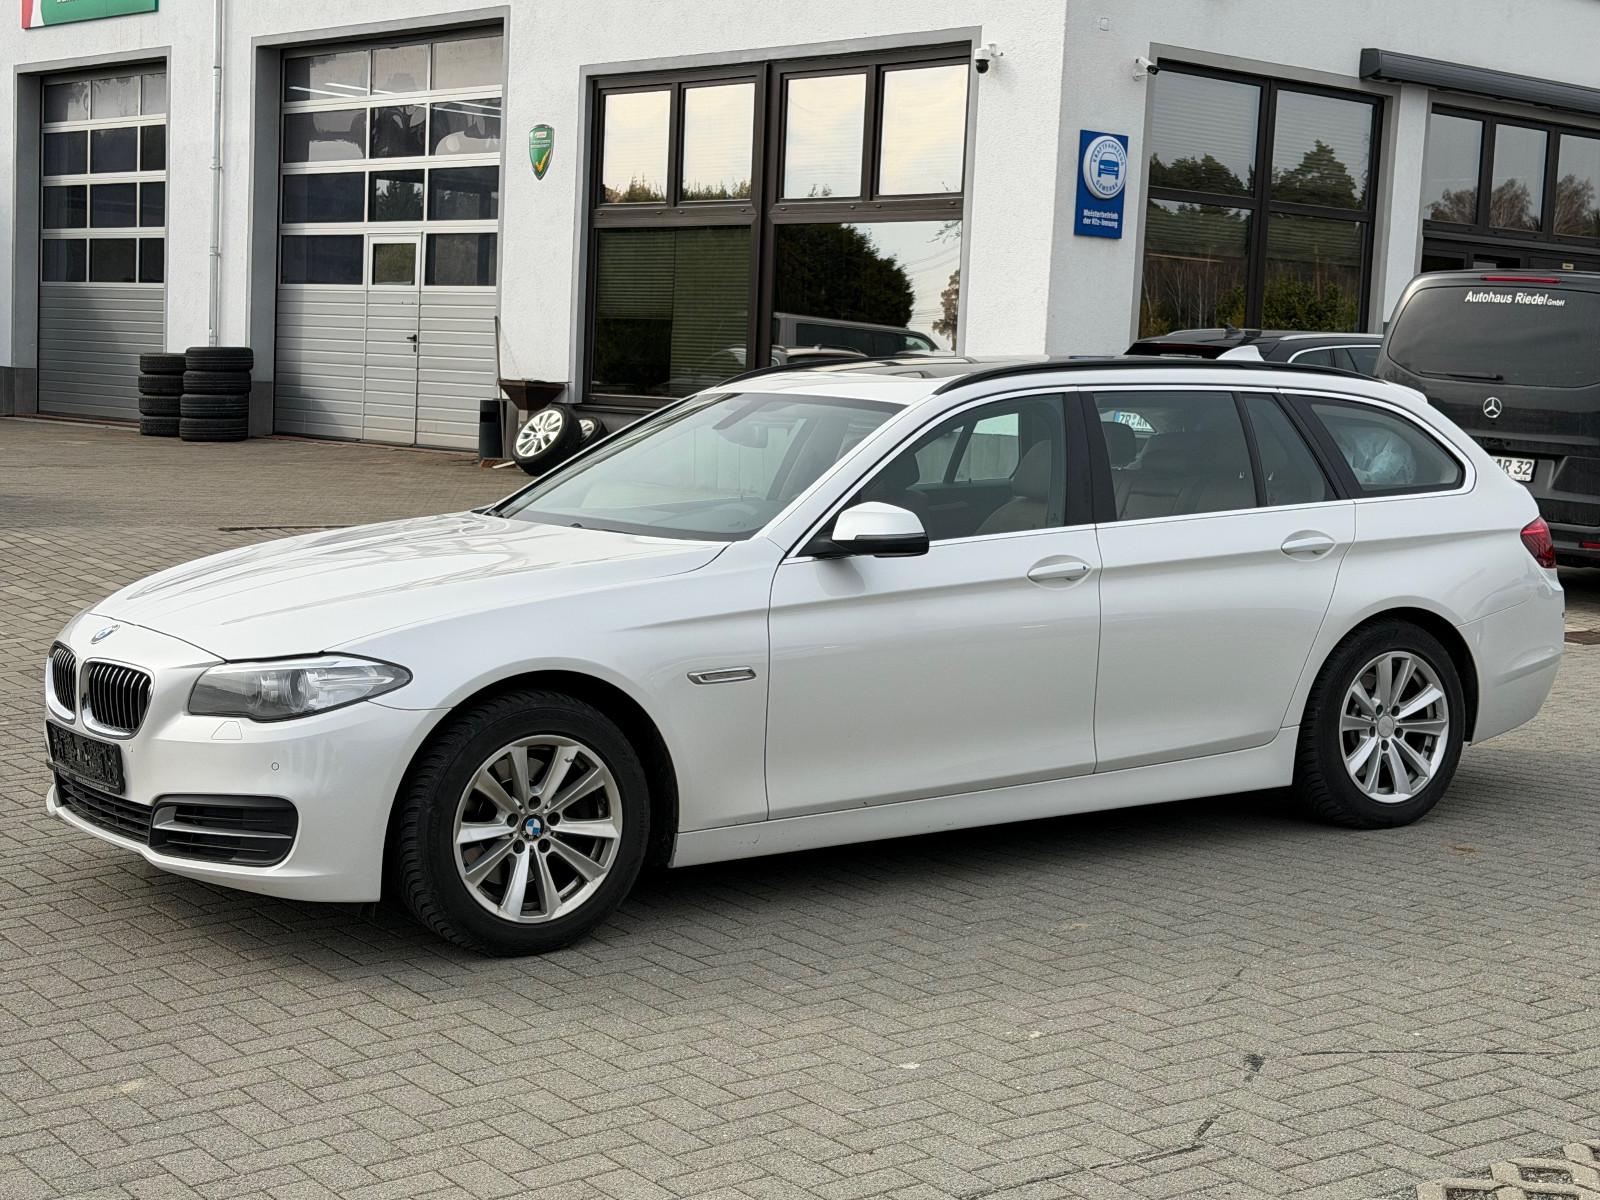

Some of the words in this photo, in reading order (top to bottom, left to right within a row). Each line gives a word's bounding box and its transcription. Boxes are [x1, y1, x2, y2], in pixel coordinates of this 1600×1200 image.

[1464, 290, 1513, 304] Autohaus
[1514, 292, 1549, 305] Riedel
[1513, 460, 1532, 476] 32
